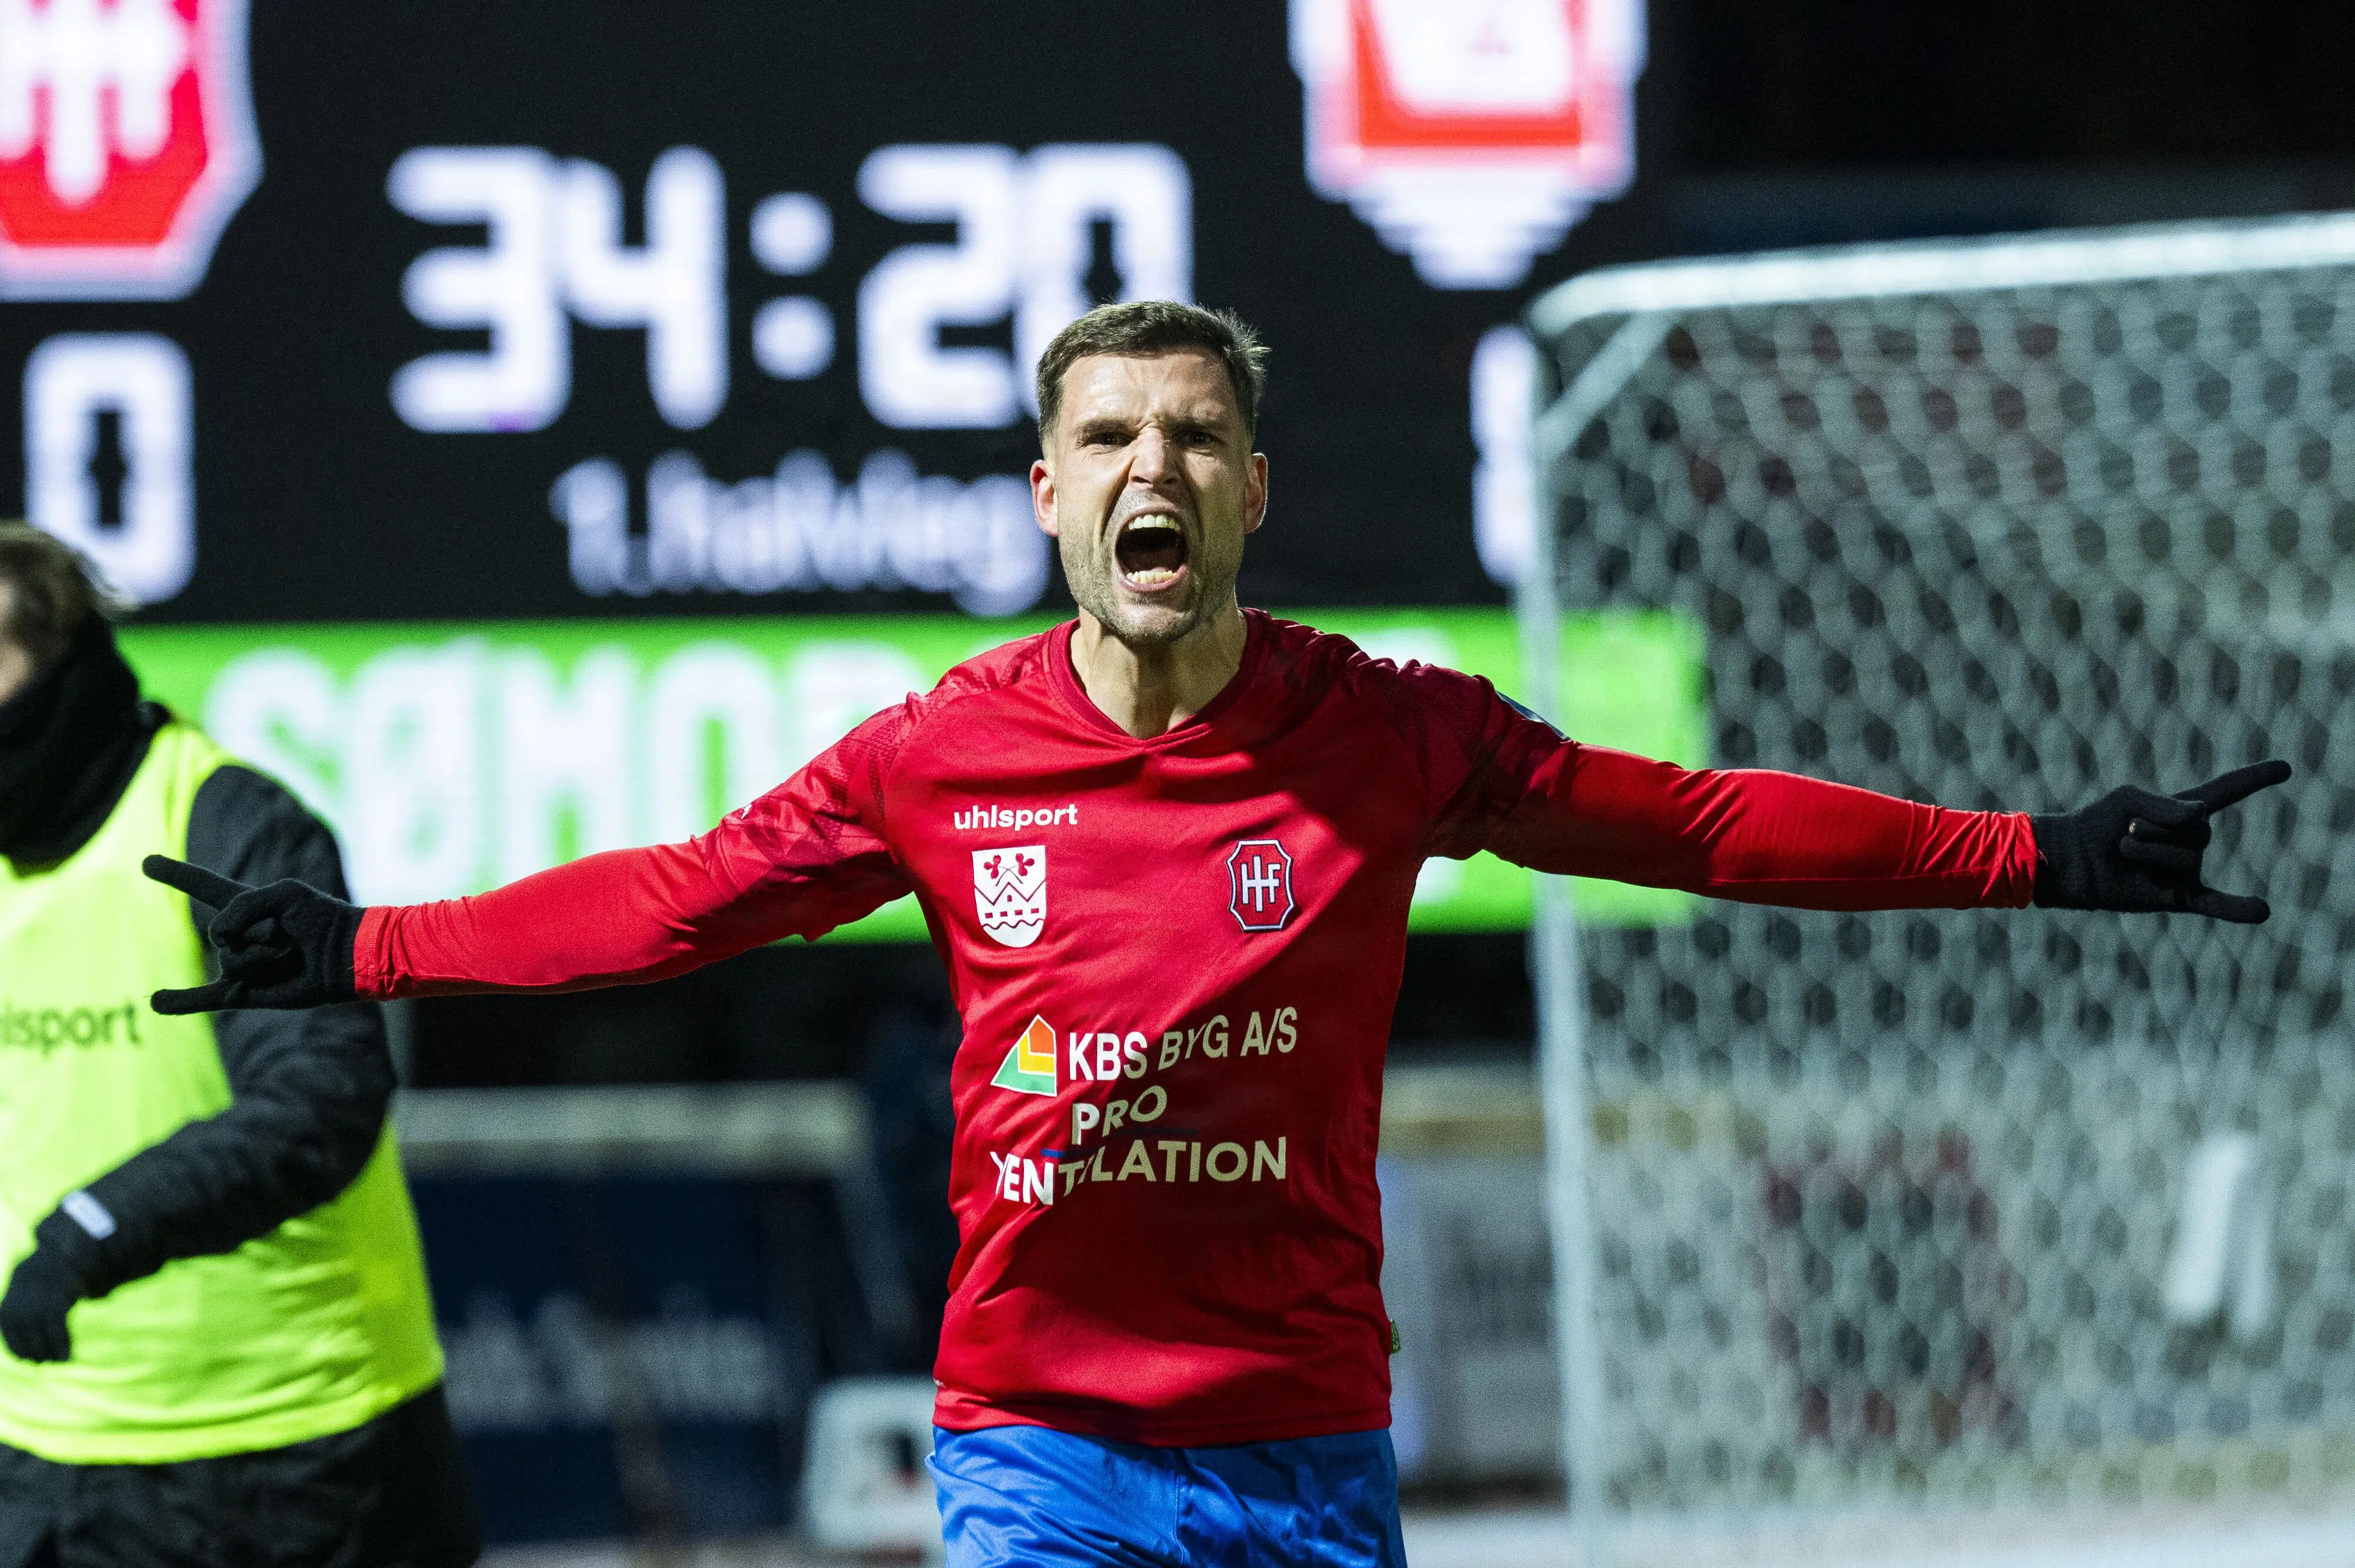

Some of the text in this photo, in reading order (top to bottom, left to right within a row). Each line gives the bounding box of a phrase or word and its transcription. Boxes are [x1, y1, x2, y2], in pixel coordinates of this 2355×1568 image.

[386, 142, 1193, 433] 34:20
[22, 331, 196, 605] 0
[953, 803, 1079, 832] uhlsport
[1069, 1006, 1298, 1079] KBS BYG A/S
[1071, 1085, 1168, 1145] PRO
